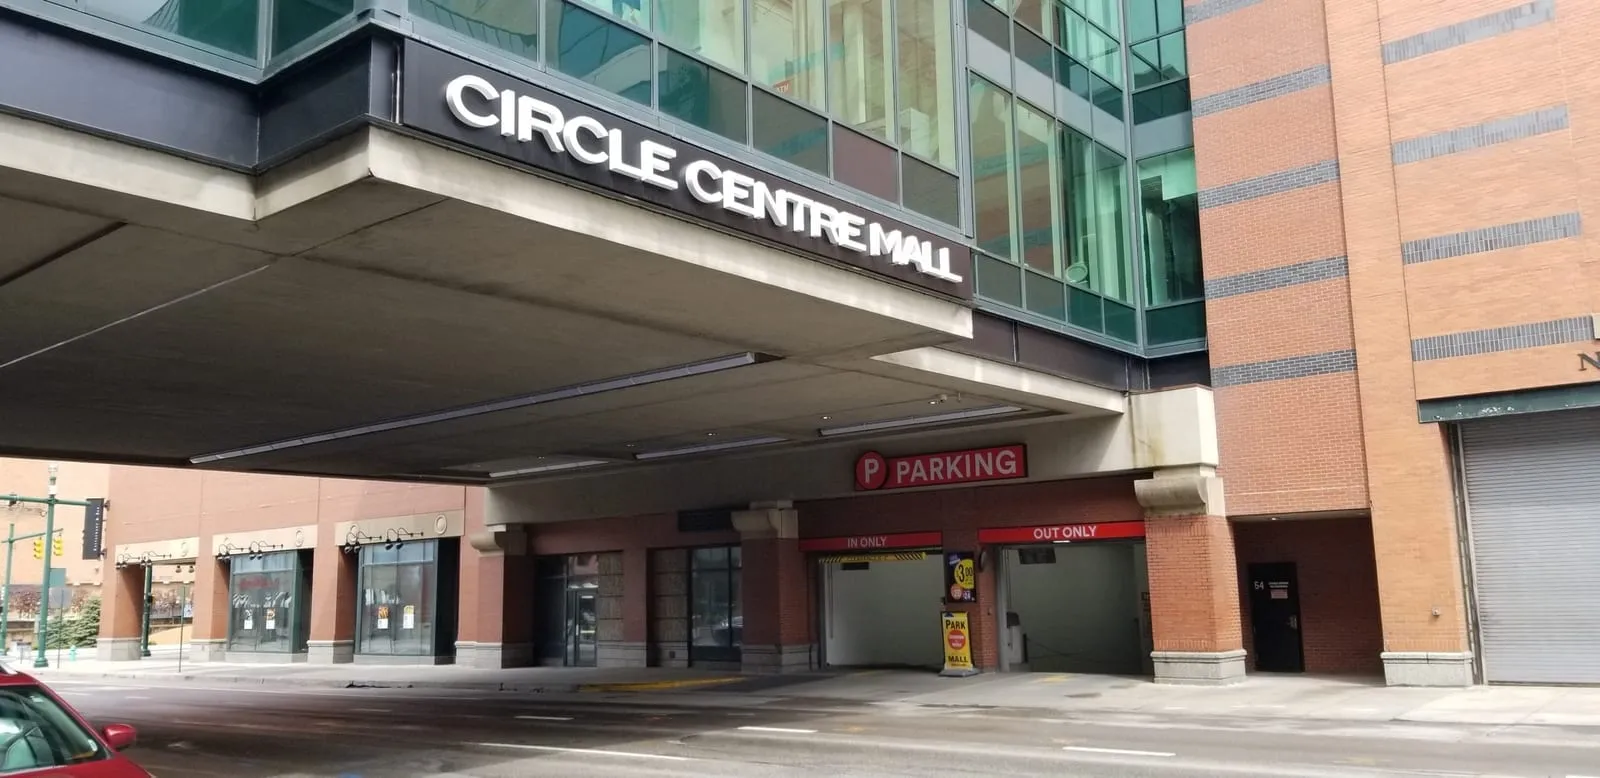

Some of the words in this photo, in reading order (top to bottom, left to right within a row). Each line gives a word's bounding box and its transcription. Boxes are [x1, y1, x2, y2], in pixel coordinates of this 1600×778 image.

[445, 73, 679, 192] CIRCLE
[684, 159, 868, 253] CENTRE
[869, 221, 963, 284] MALL
[864, 458, 880, 484] P
[896, 450, 1017, 484] PARKING
[1033, 527, 1060, 540] OUT
[1062, 525, 1097, 538] ONLY
[847, 537, 858, 548] IN
[860, 535, 887, 548] ONLY
[945, 620, 966, 630] PARK
[948, 655, 968, 663] MALL
